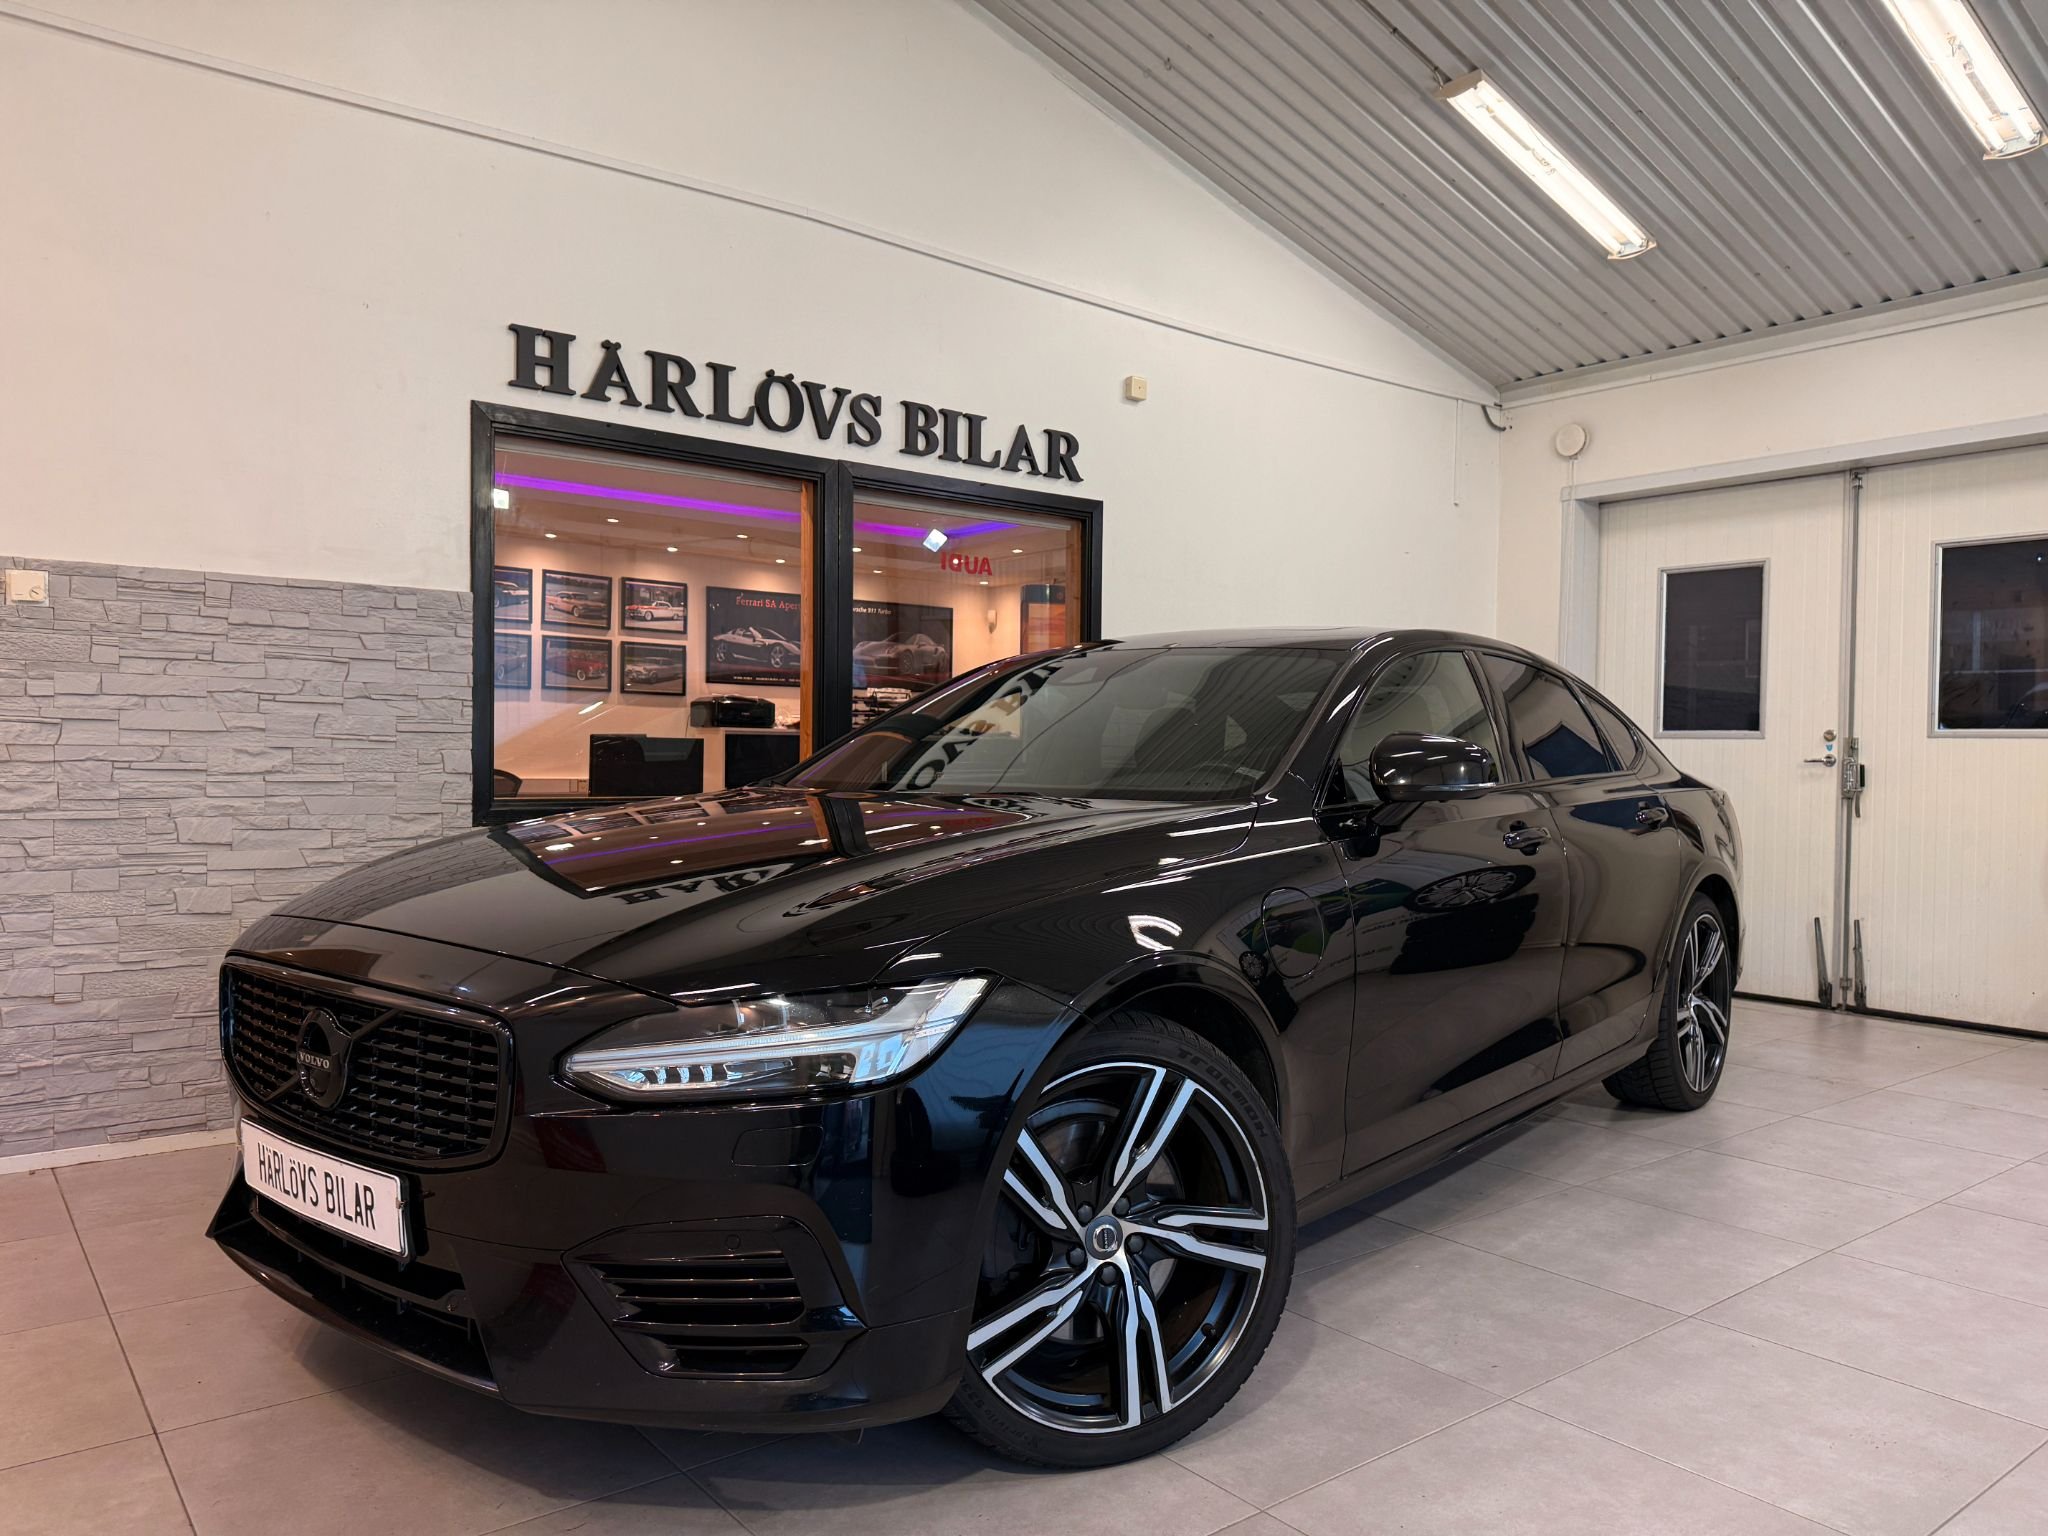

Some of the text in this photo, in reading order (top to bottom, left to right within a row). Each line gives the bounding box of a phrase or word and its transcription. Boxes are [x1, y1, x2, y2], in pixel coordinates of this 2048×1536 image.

[507, 322, 1085, 482] HÄRLÖVS BILAR
[735, 596, 764, 608] Ferrari
[298, 1051, 330, 1069] VOLVO
[257, 1142, 376, 1231] HÄRLÖVS BILAR
